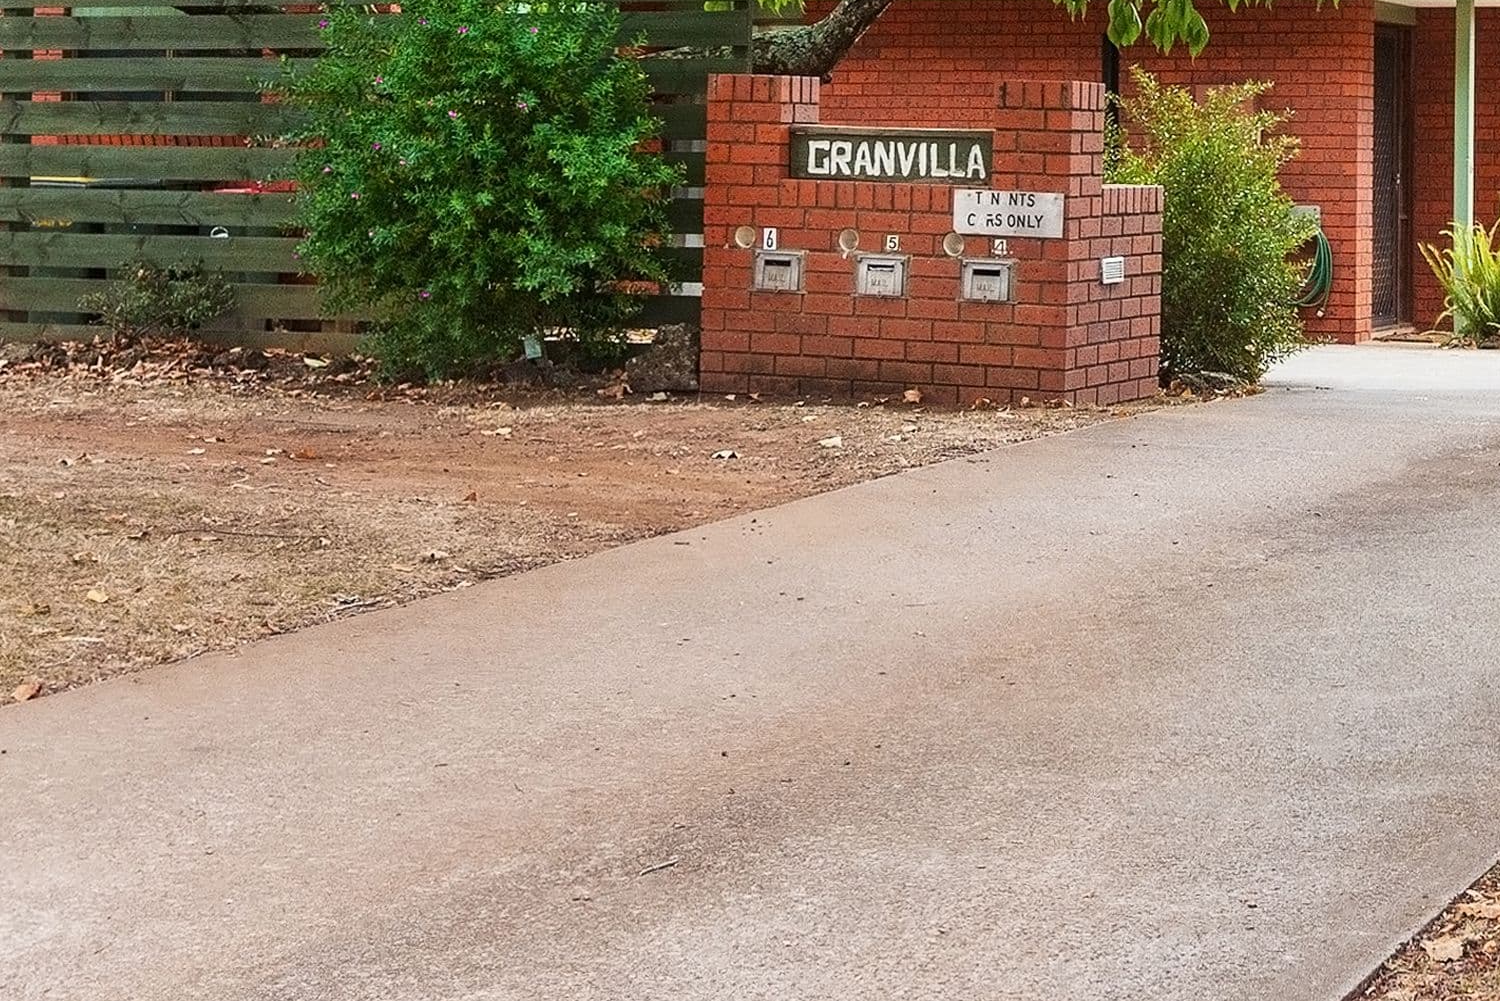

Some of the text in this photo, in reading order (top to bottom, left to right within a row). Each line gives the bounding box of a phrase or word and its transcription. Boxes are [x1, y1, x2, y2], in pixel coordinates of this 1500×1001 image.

[807, 139, 986, 180] GRANVILLA
[975, 191, 1036, 208] TNNTS
[967, 212, 1044, 229] CRS ONLY
[766, 229, 774, 248] 6
[888, 236, 897, 249] 5
[993, 240, 1006, 256] 4
